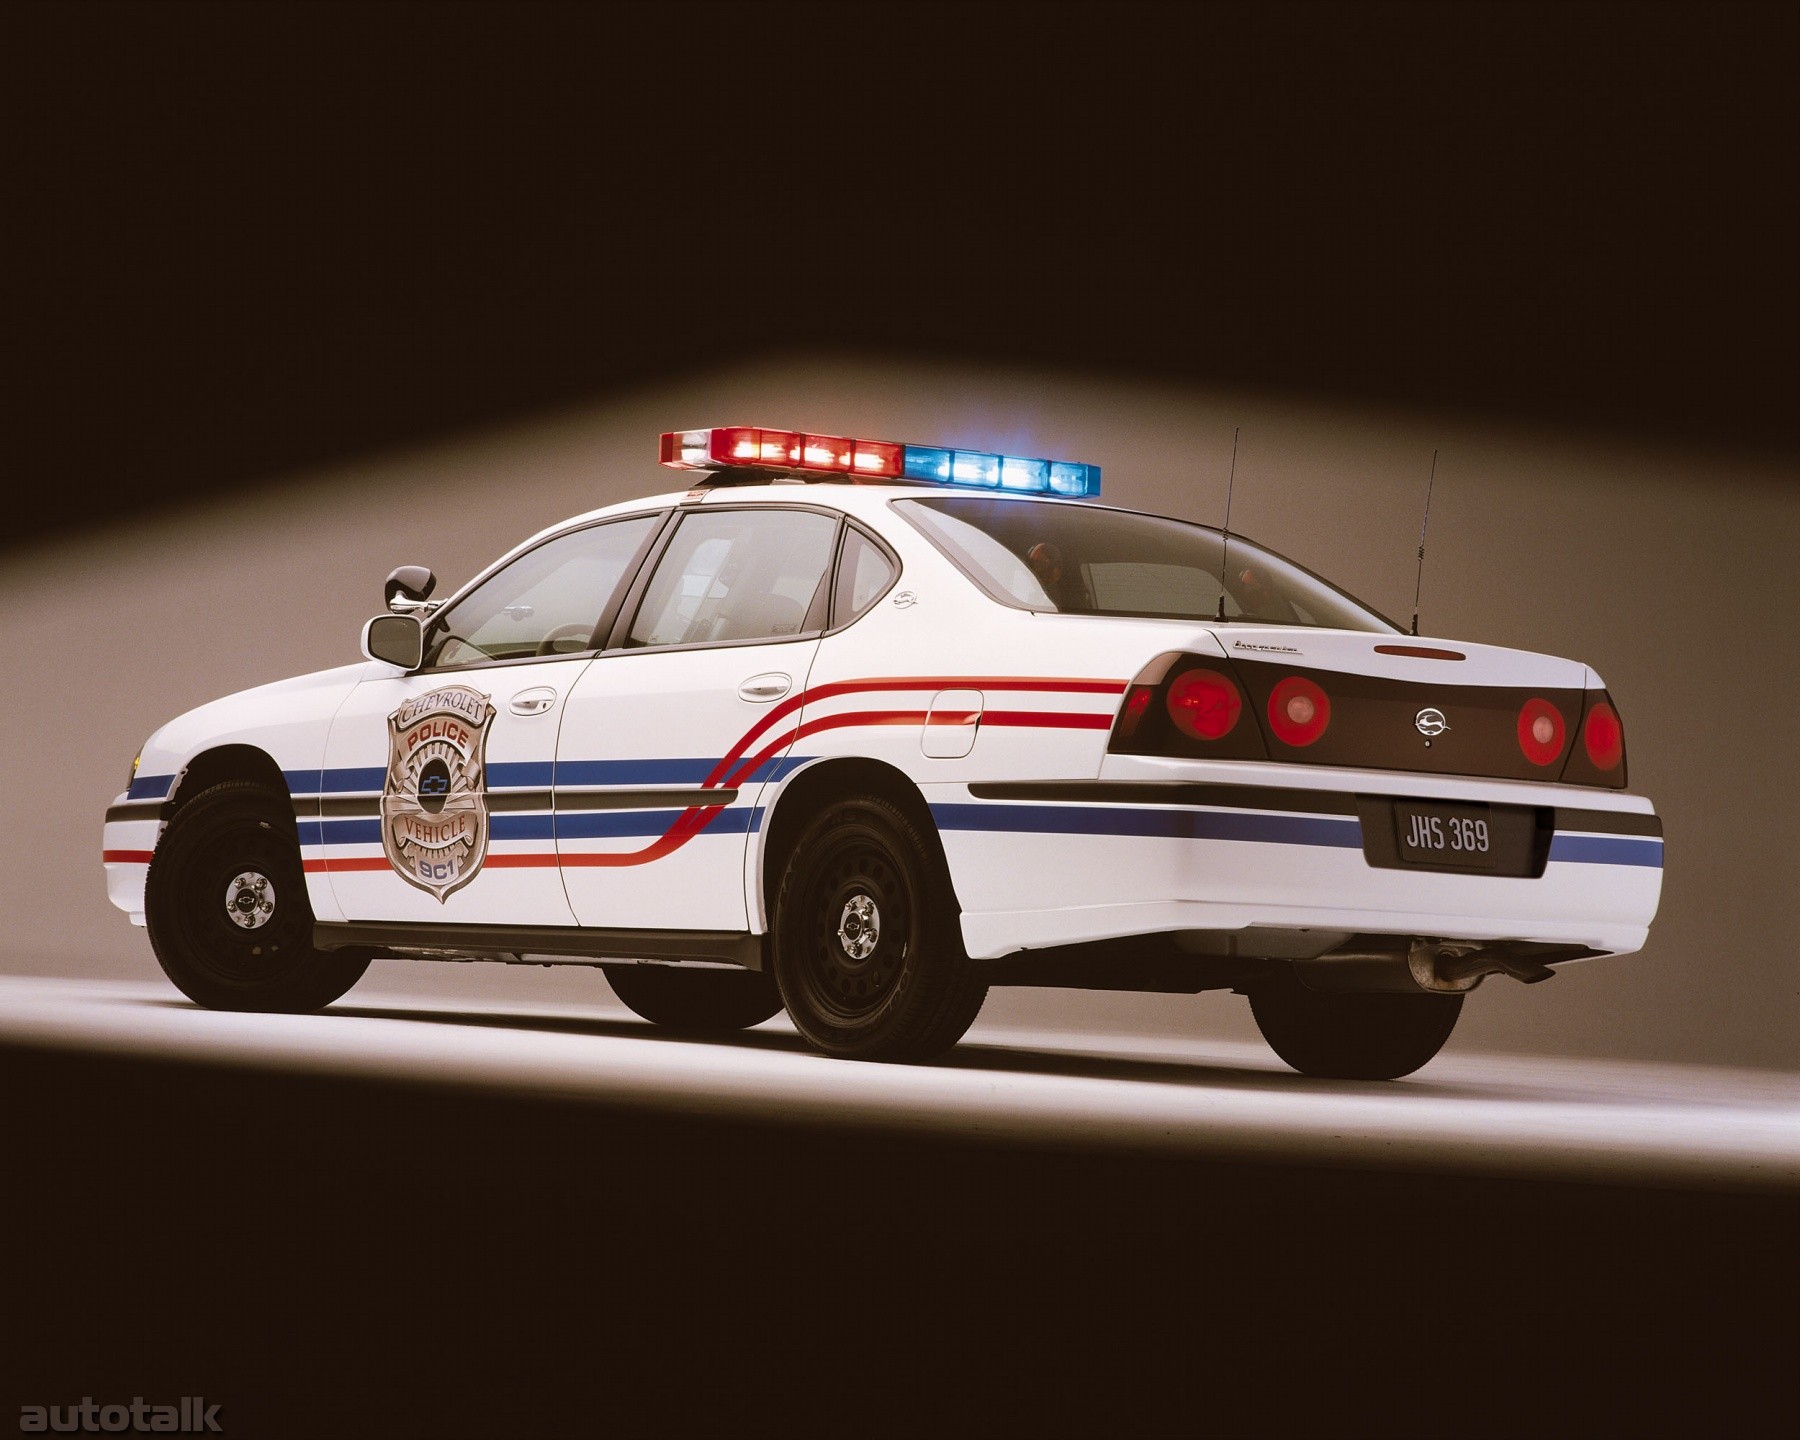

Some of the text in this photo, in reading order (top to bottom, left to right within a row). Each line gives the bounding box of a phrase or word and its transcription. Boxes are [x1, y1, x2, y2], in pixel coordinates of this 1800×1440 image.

[402, 692, 487, 722] CHEVROLET
[407, 721, 469, 751] POLICE
[404, 815, 466, 843] VEHICLE
[1406, 814, 1490, 852] JHS 369
[419, 860, 455, 879] 9C1
